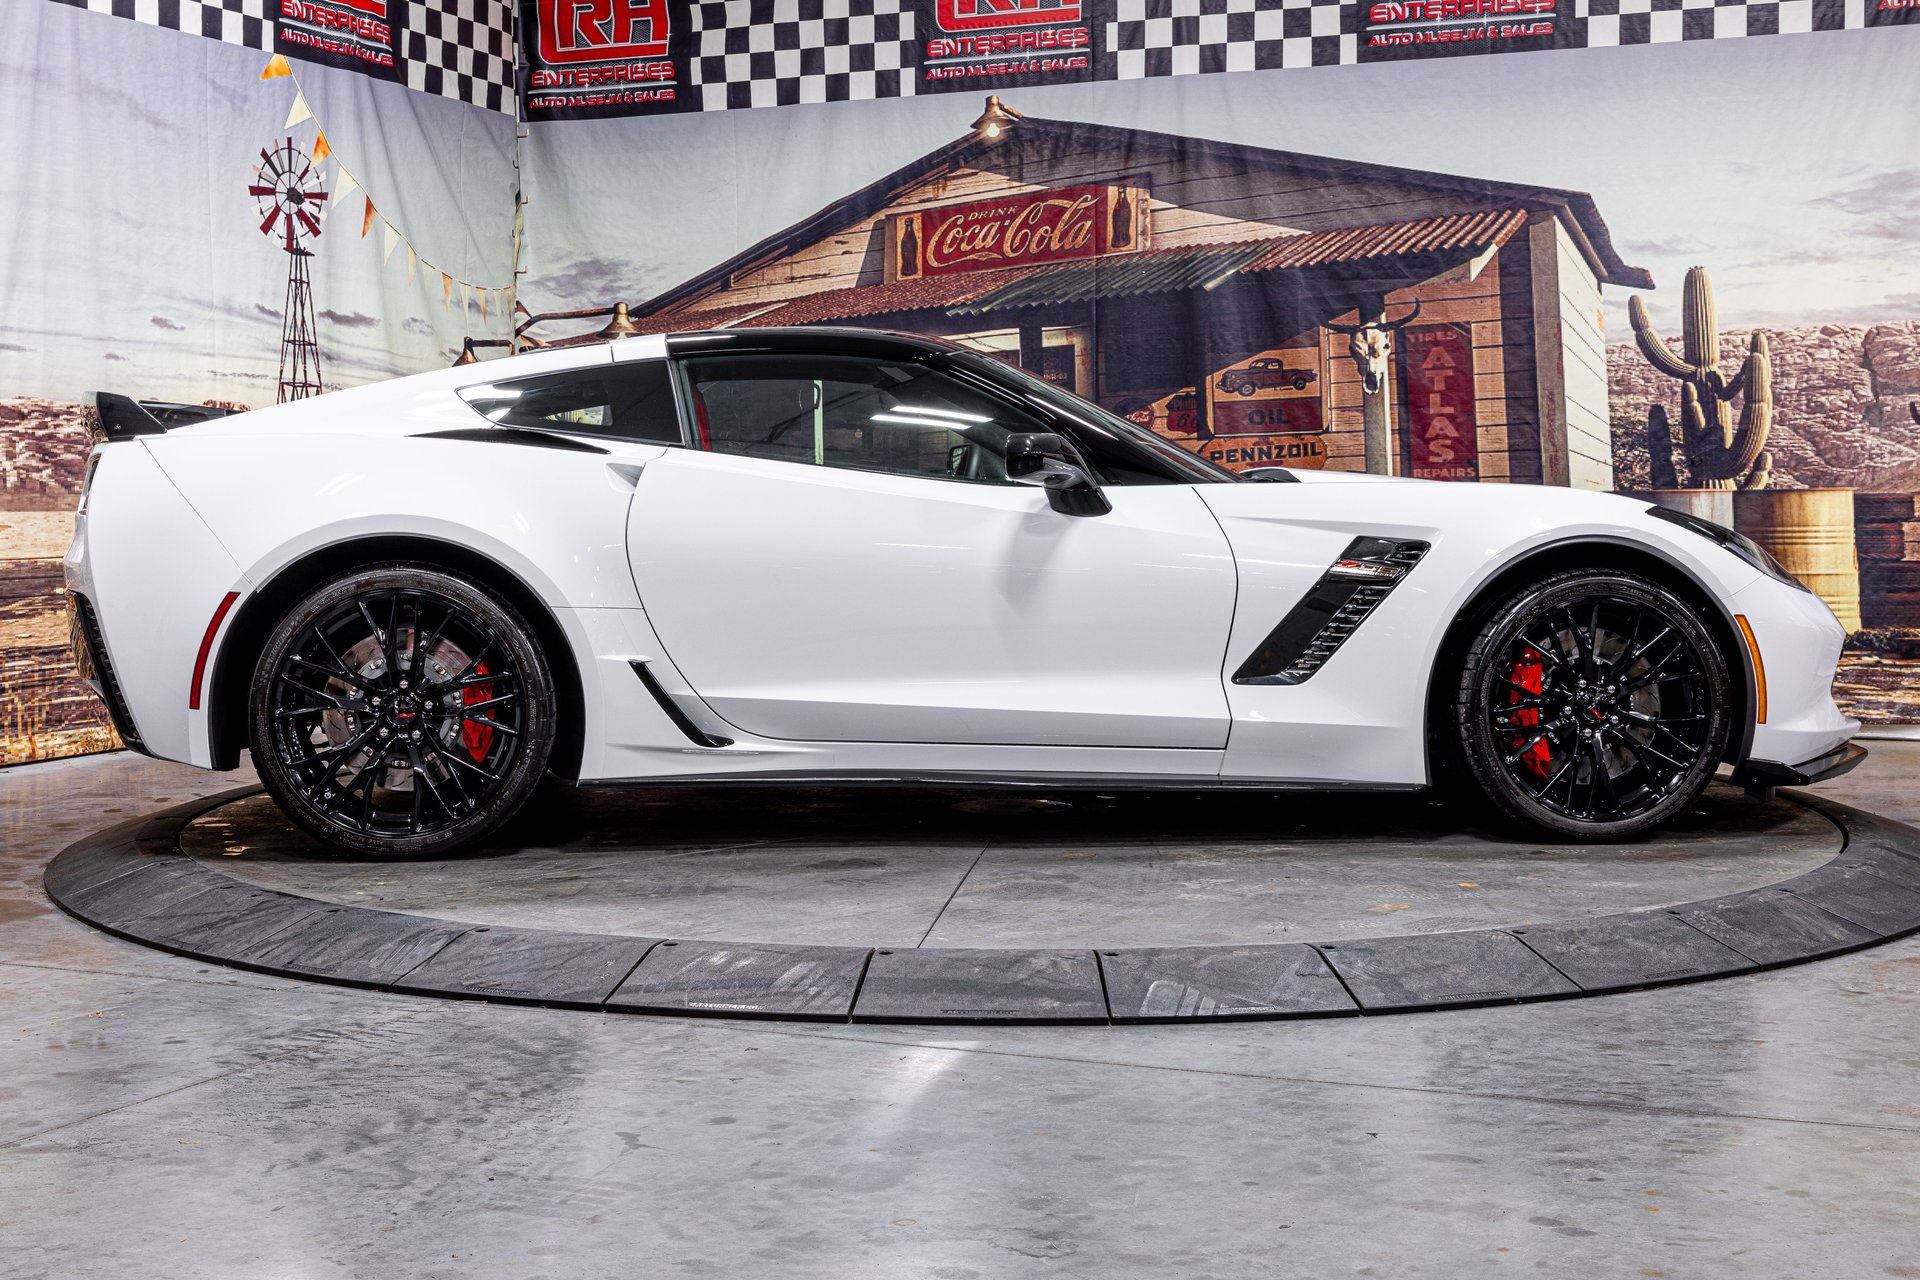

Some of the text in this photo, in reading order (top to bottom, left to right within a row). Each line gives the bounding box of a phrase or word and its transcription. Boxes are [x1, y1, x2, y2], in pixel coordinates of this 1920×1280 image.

[281, 0, 391, 43] ENTERPRISES
[1369, 0, 1555, 22] ENTERPRISES
[927, 27, 1089, 57] ENTERPRISES
[1368, 22, 1554, 47] AUTO MUSEUM & SALES
[280, 28, 309, 45] AUTO
[309, 34, 355, 56] MUSEUM
[362, 48, 394, 67] SALES
[531, 61, 676, 87] ENTERPRISES
[925, 56, 1089, 81] AUTO MUSEUM & SALES
[529, 89, 677, 109] AUTO MUSEUM & SALES
[968, 205, 1019, 221] DRINK
[926, 193, 1103, 268] Coca-Cola
[1407, 331, 1458, 343] TIRES
[1247, 407, 1290, 426] OIL
[1422, 346, 1460, 463] ATLAS
[1209, 442, 1322, 463] PENNZOIL
[1412, 467, 1476, 479] REPAIRS
